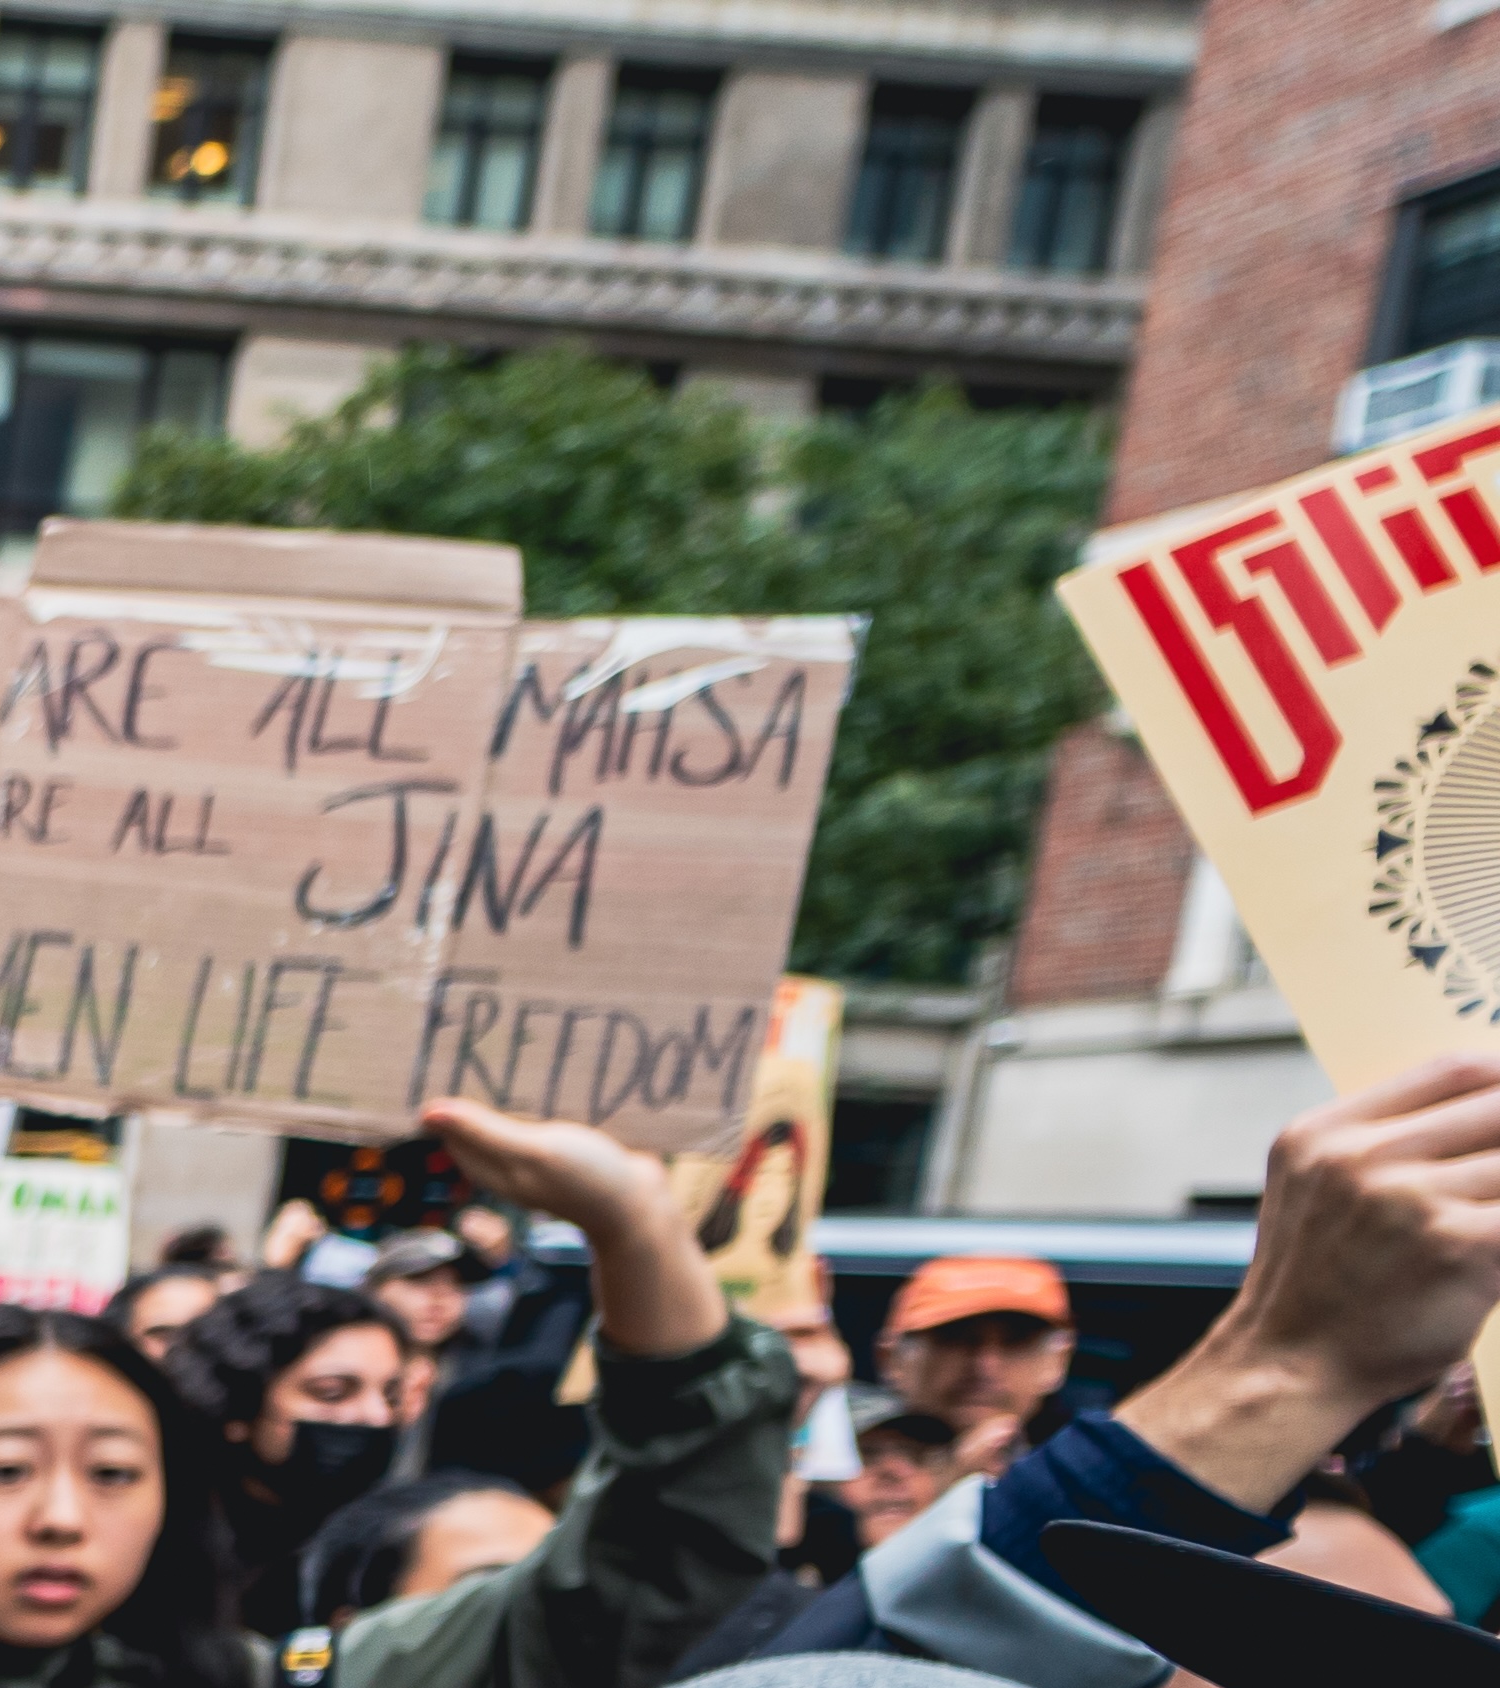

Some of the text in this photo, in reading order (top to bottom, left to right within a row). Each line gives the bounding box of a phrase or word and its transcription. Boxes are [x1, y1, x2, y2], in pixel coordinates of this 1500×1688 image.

[251, 646, 429, 777] ALL
[488, 658, 807, 797] MAHSA
[112, 786, 233, 856] ALL
[295, 778, 603, 951] JINA
[173, 953, 381, 1101] LIFE
